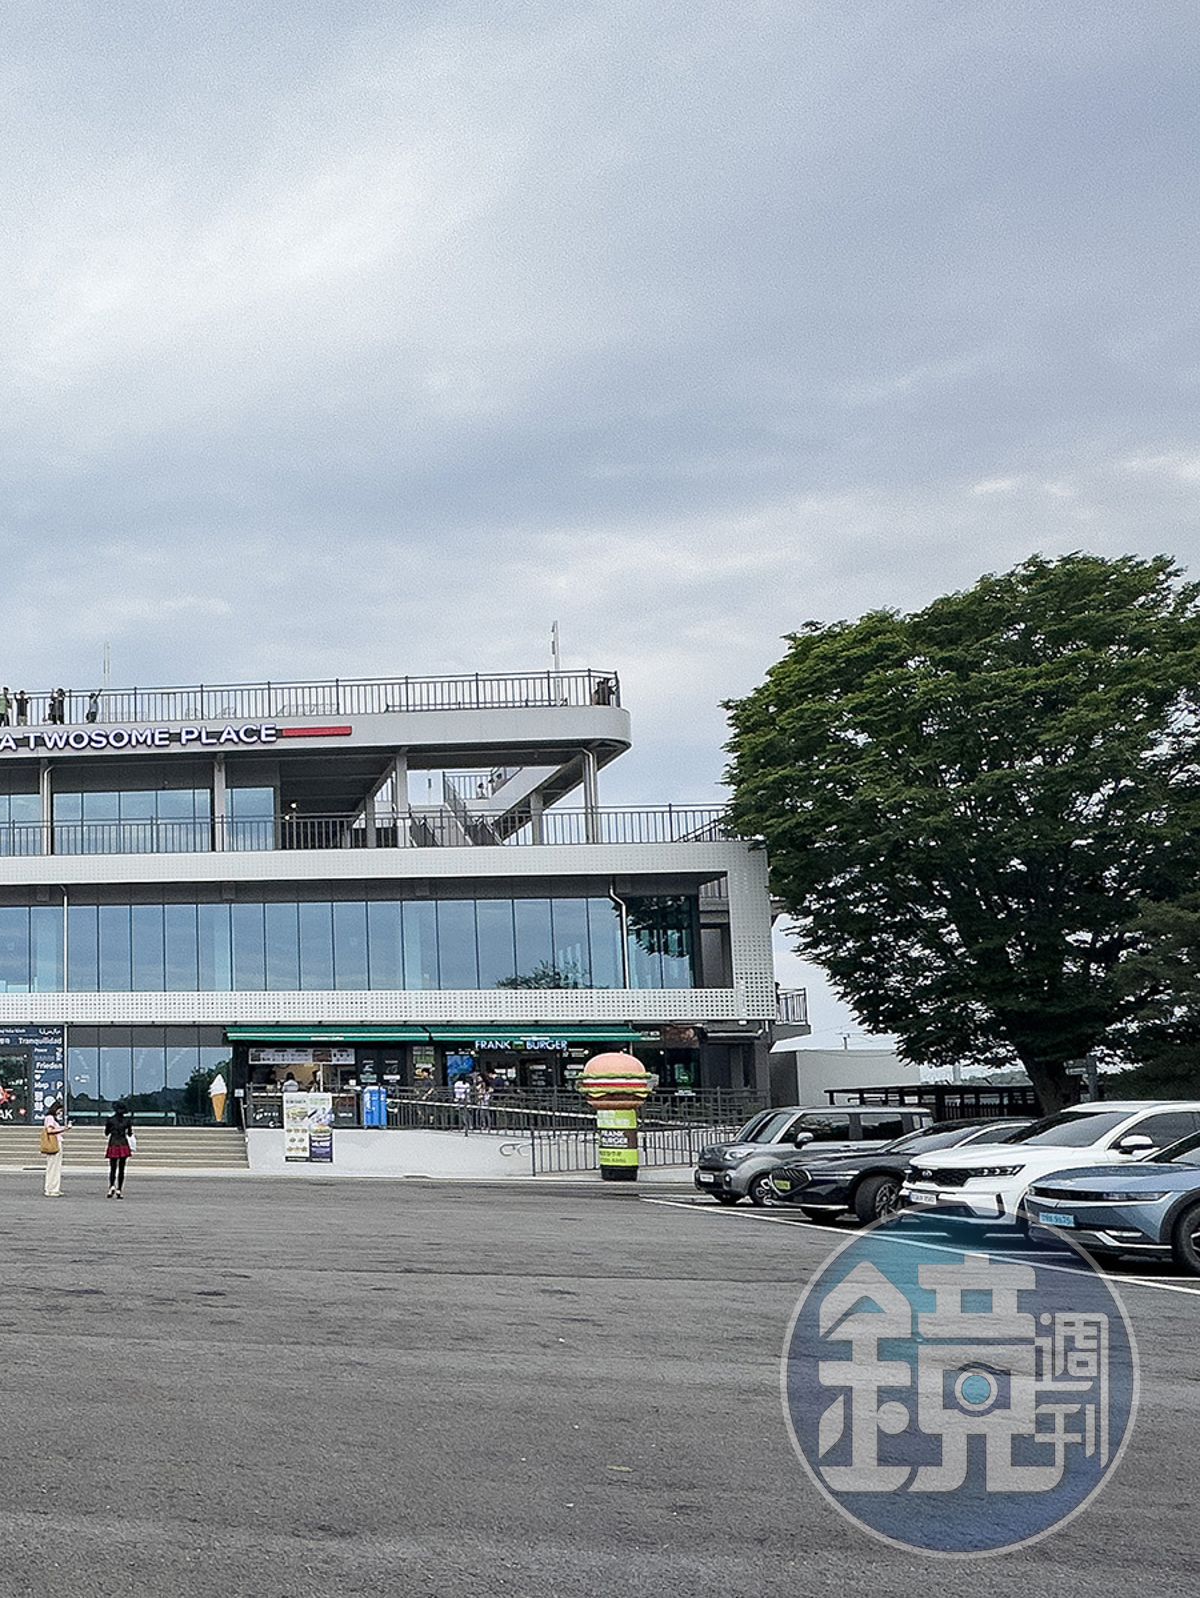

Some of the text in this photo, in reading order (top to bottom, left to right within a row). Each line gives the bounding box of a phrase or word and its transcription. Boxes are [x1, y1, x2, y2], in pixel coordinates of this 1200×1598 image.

[25, 727, 171, 750] TWOSOME
[180, 724, 278, 745] PLACE
[474, 1039, 568, 1050] FRANK BURGER
